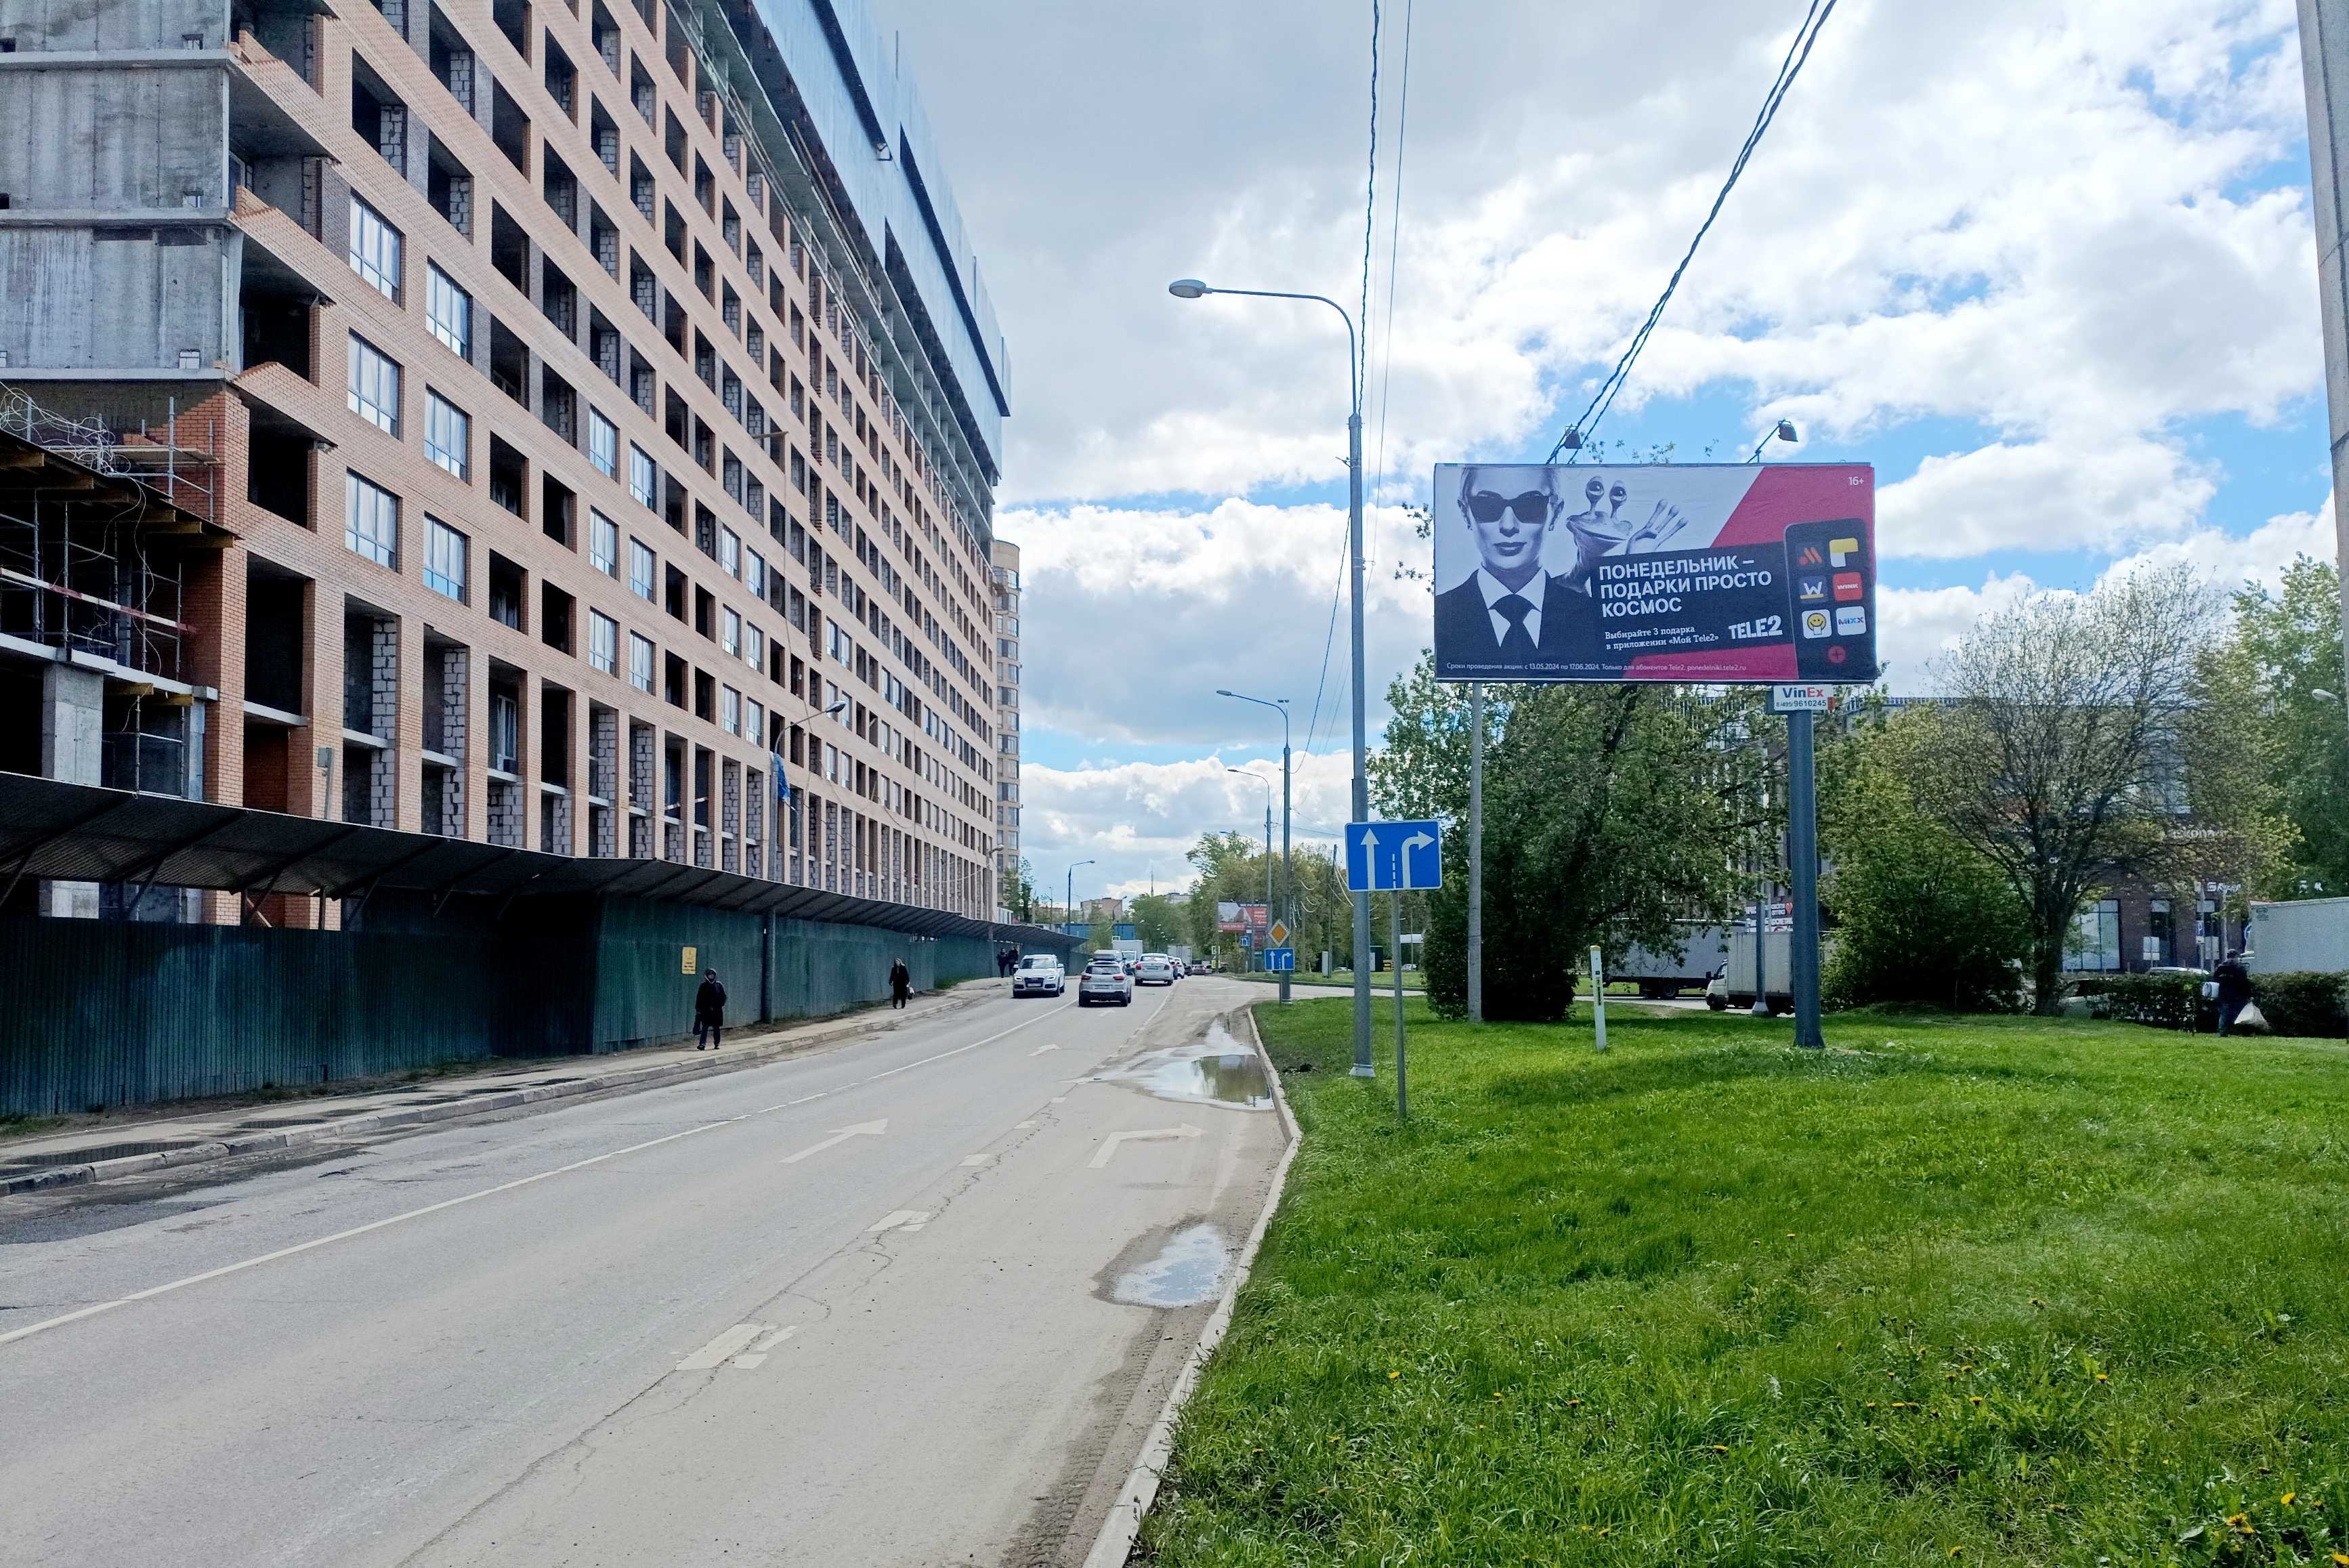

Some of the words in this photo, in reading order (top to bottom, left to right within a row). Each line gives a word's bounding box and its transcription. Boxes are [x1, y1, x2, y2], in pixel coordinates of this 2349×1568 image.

[1848, 476, 1864, 486] 16+
[1599, 555, 1738, 581] ПОНЕДЕЛЬНИК
[1601, 578, 1691, 599] ПОДАРКИ
[1695, 570, 1773, 592] ПРОСТО
[1602, 597, 1683, 618] КОСМОС
[1605, 629, 1651, 640] Выбирайте
[1653, 627, 1659, 635] 3
[1661, 626, 1695, 635] подарка
[1728, 615, 1783, 639] TELE2
[1613, 639, 1666, 651] приложении
[1669, 636, 1691, 645] «Мой
[1693, 633, 1719, 643] Tele2»
[1782, 687, 1823, 698] VinEx
